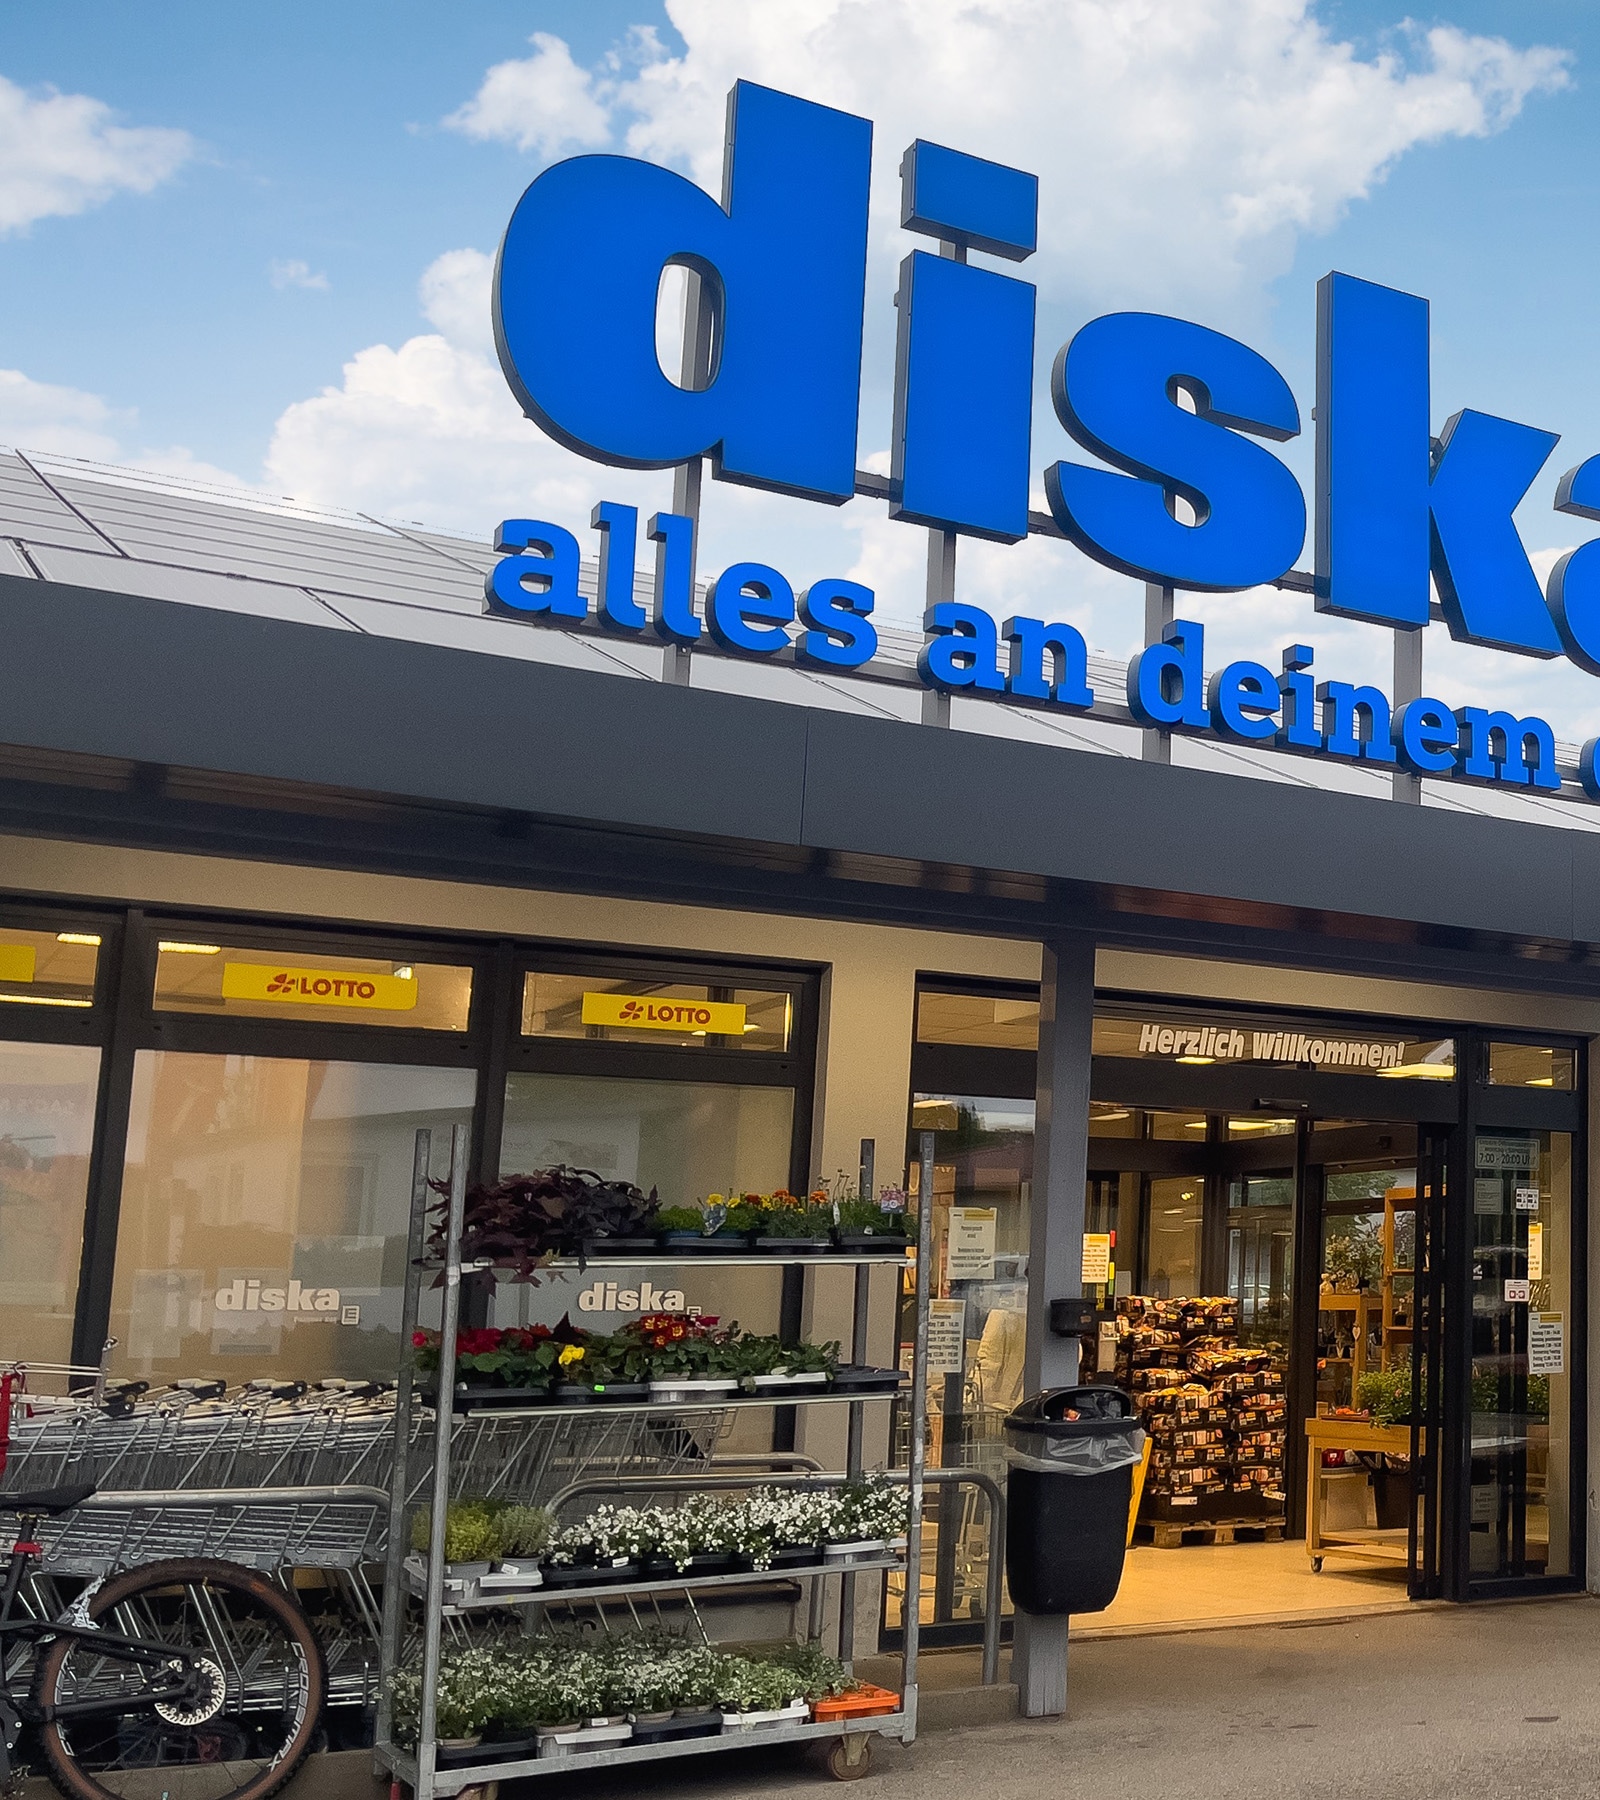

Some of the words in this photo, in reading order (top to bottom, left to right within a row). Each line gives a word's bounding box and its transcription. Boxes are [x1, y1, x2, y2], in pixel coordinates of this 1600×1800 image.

[483, 501, 878, 671] alles
[917, 602, 1094, 711] an
[1127, 619, 1561, 792] deinem
[300, 977, 375, 999] LOTTO
[647, 1004, 711, 1024] LOTTO
[1138, 1024, 1244, 1058] Herzlich
[1252, 1031, 1405, 1067] Willkommen!
[215, 1279, 340, 1311] diska
[578, 1282, 685, 1311] diska
